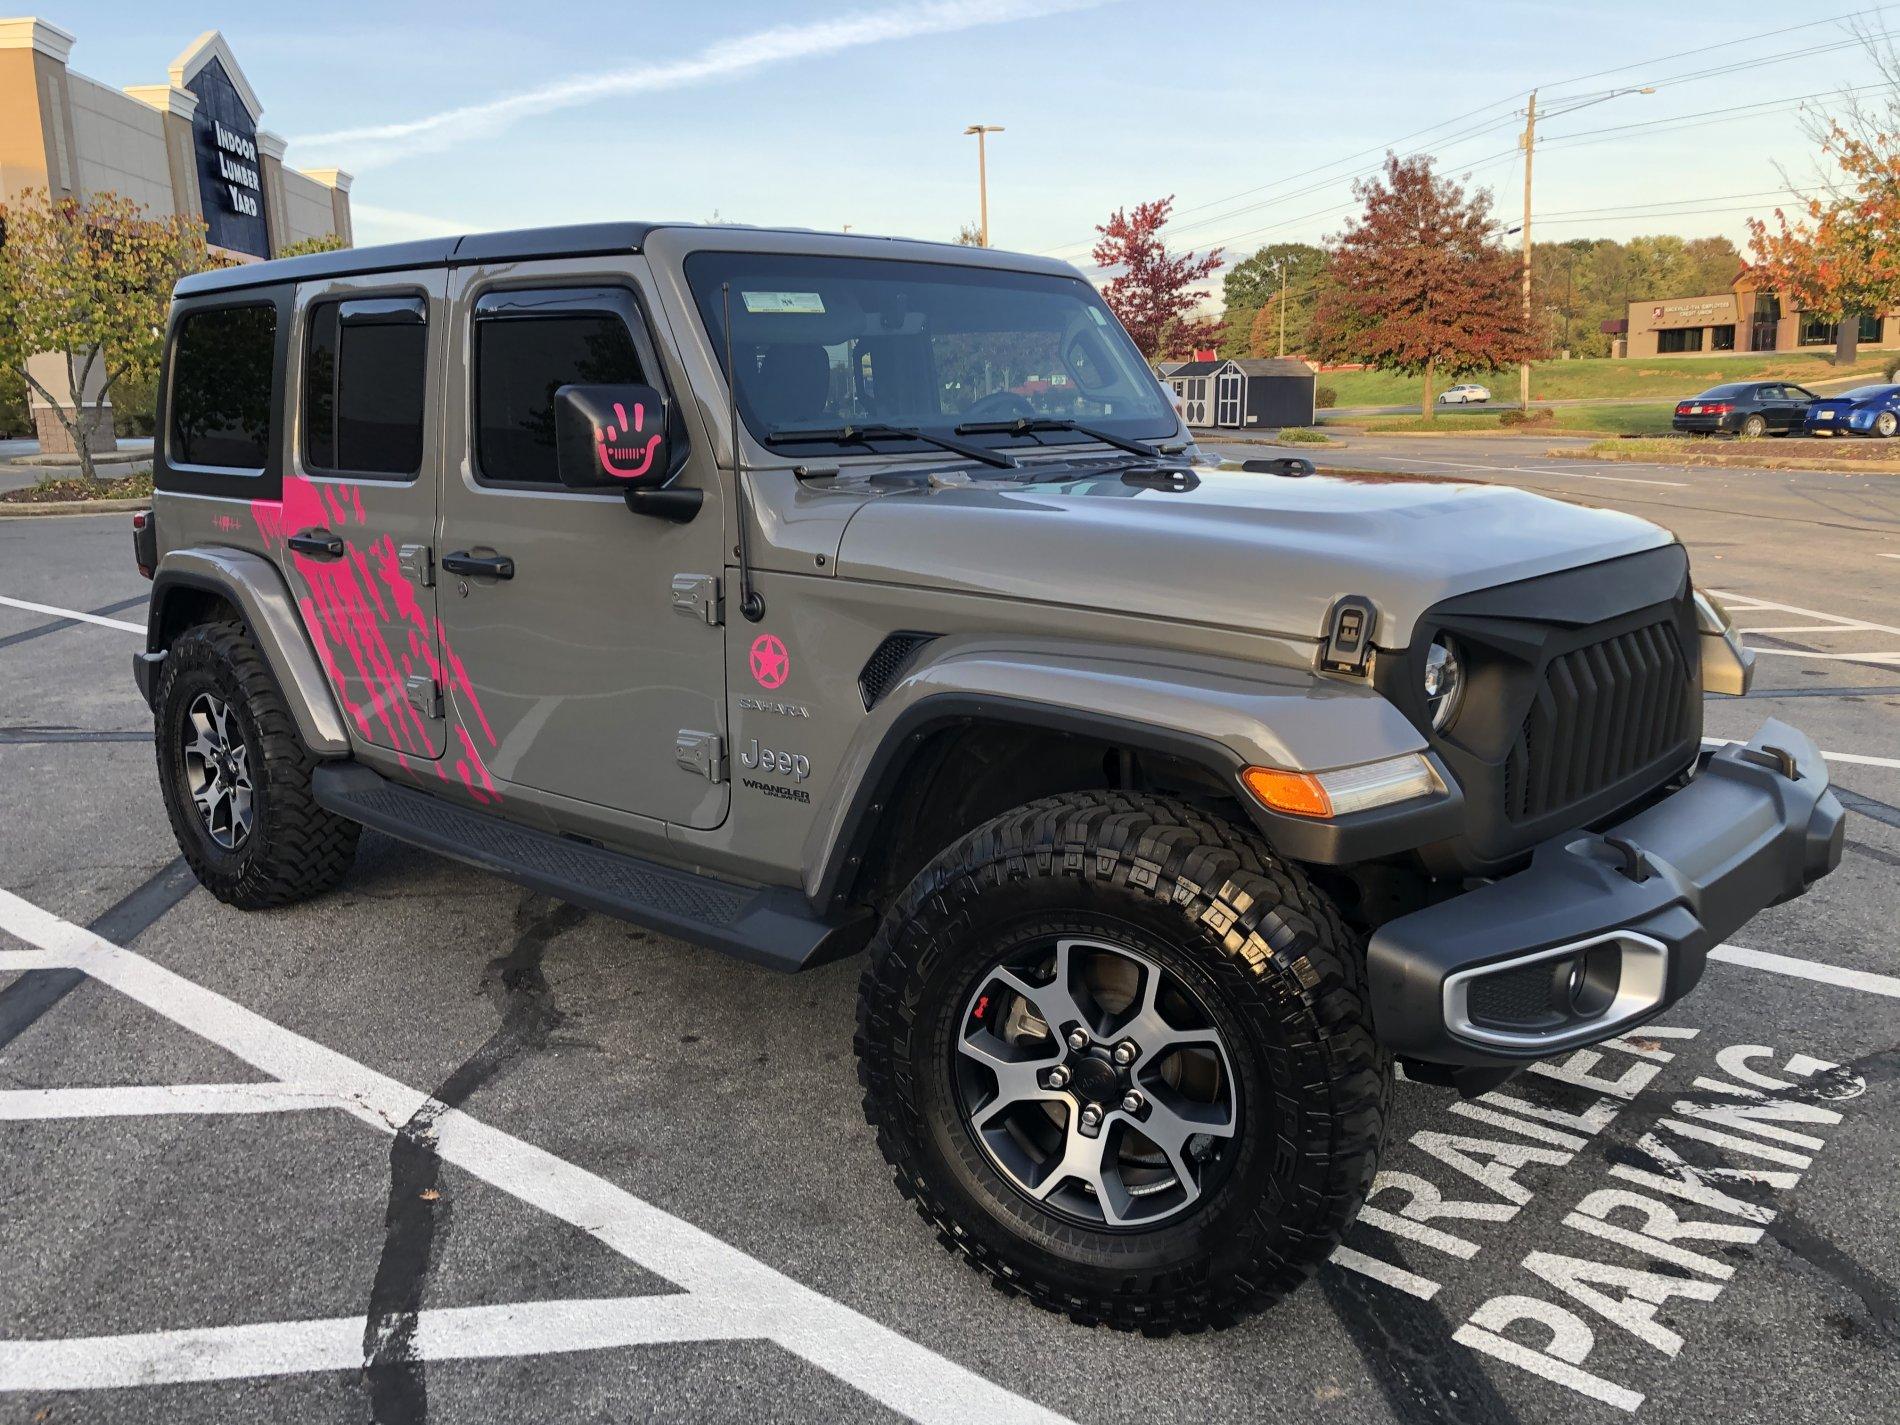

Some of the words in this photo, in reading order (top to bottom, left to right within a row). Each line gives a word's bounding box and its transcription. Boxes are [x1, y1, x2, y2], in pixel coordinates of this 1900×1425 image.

[215, 120, 256, 162] INDOOR
[219, 151, 259, 191] LUMBER
[228, 184, 257, 217] YARD
[738, 699, 810, 719] SAHARA
[741, 739, 811, 785] Jeep
[742, 778, 811, 800] WRANGLER
[763, 790, 811, 804] UNLIMITED
[1452, 1044, 1867, 1413] PARKING
